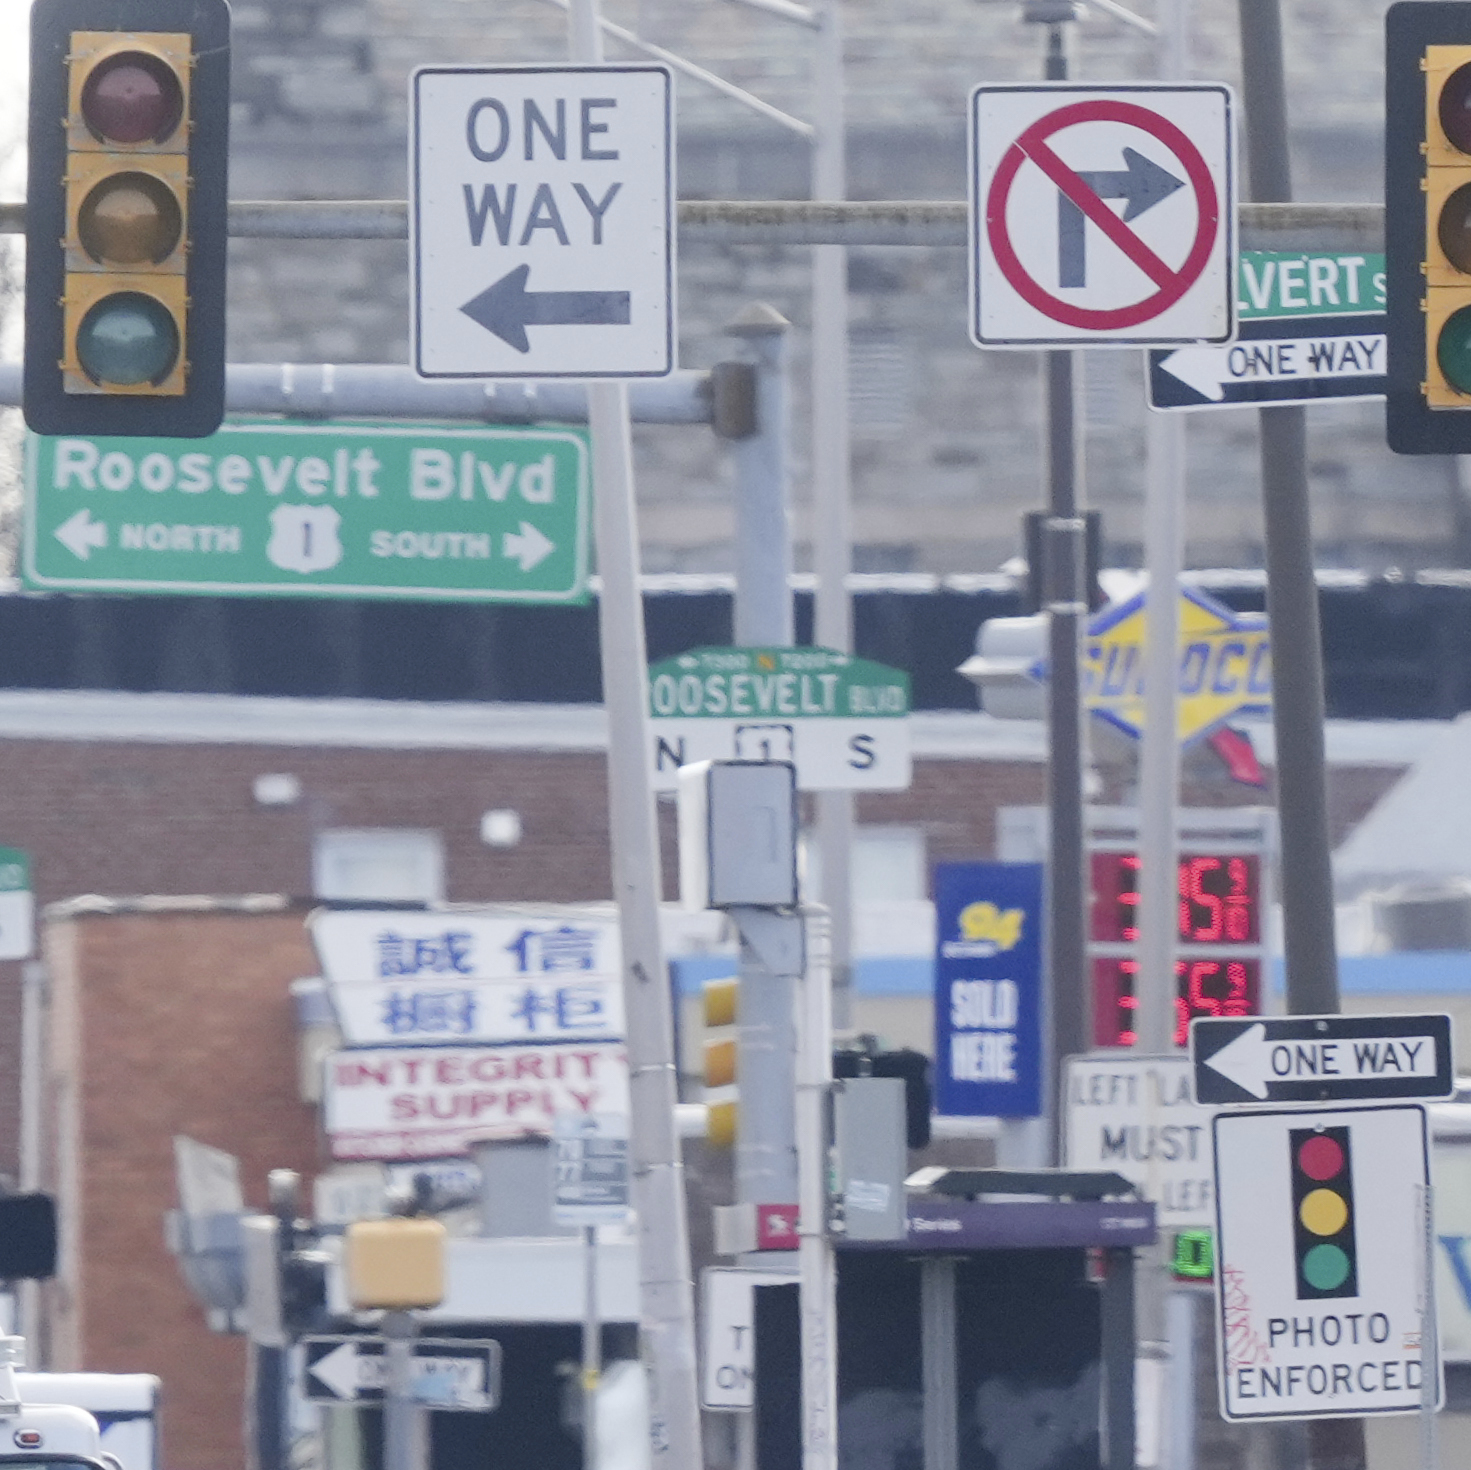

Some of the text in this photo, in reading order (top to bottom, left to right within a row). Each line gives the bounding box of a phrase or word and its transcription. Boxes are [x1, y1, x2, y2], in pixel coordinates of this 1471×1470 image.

[466, 98, 620, 161] ONE
[462, 183, 622, 246] WAY
[1238, 256, 1387, 310] VERT S
[1228, 339, 1381, 377] ONE WAY
[53, 439, 556, 503] Roosevelt Blvd
[120, 523, 241, 553] NORTH
[369, 529, 491, 560] SOUTH
[1088, 643, 1272, 697] UOCO
[652, 673, 839, 715] OOSEVELT
[657, 735, 684, 771] N
[848, 733, 875, 769] S
[951, 978, 1019, 1029] SOLD
[951, 1031, 1018, 1083] HERE
[1271, 1041, 1425, 1077] ONE WAY
[391, 1090, 599, 1119] SUPPLY
[1071, 1074, 1191, 1106] LEFT LA
[1102, 1125, 1203, 1161] MUST
[1163, 1179, 1212, 1211] LEF
[1268, 1313, 1389, 1348] PHOTO
[1237, 1360, 1422, 1399] ENFORCED
